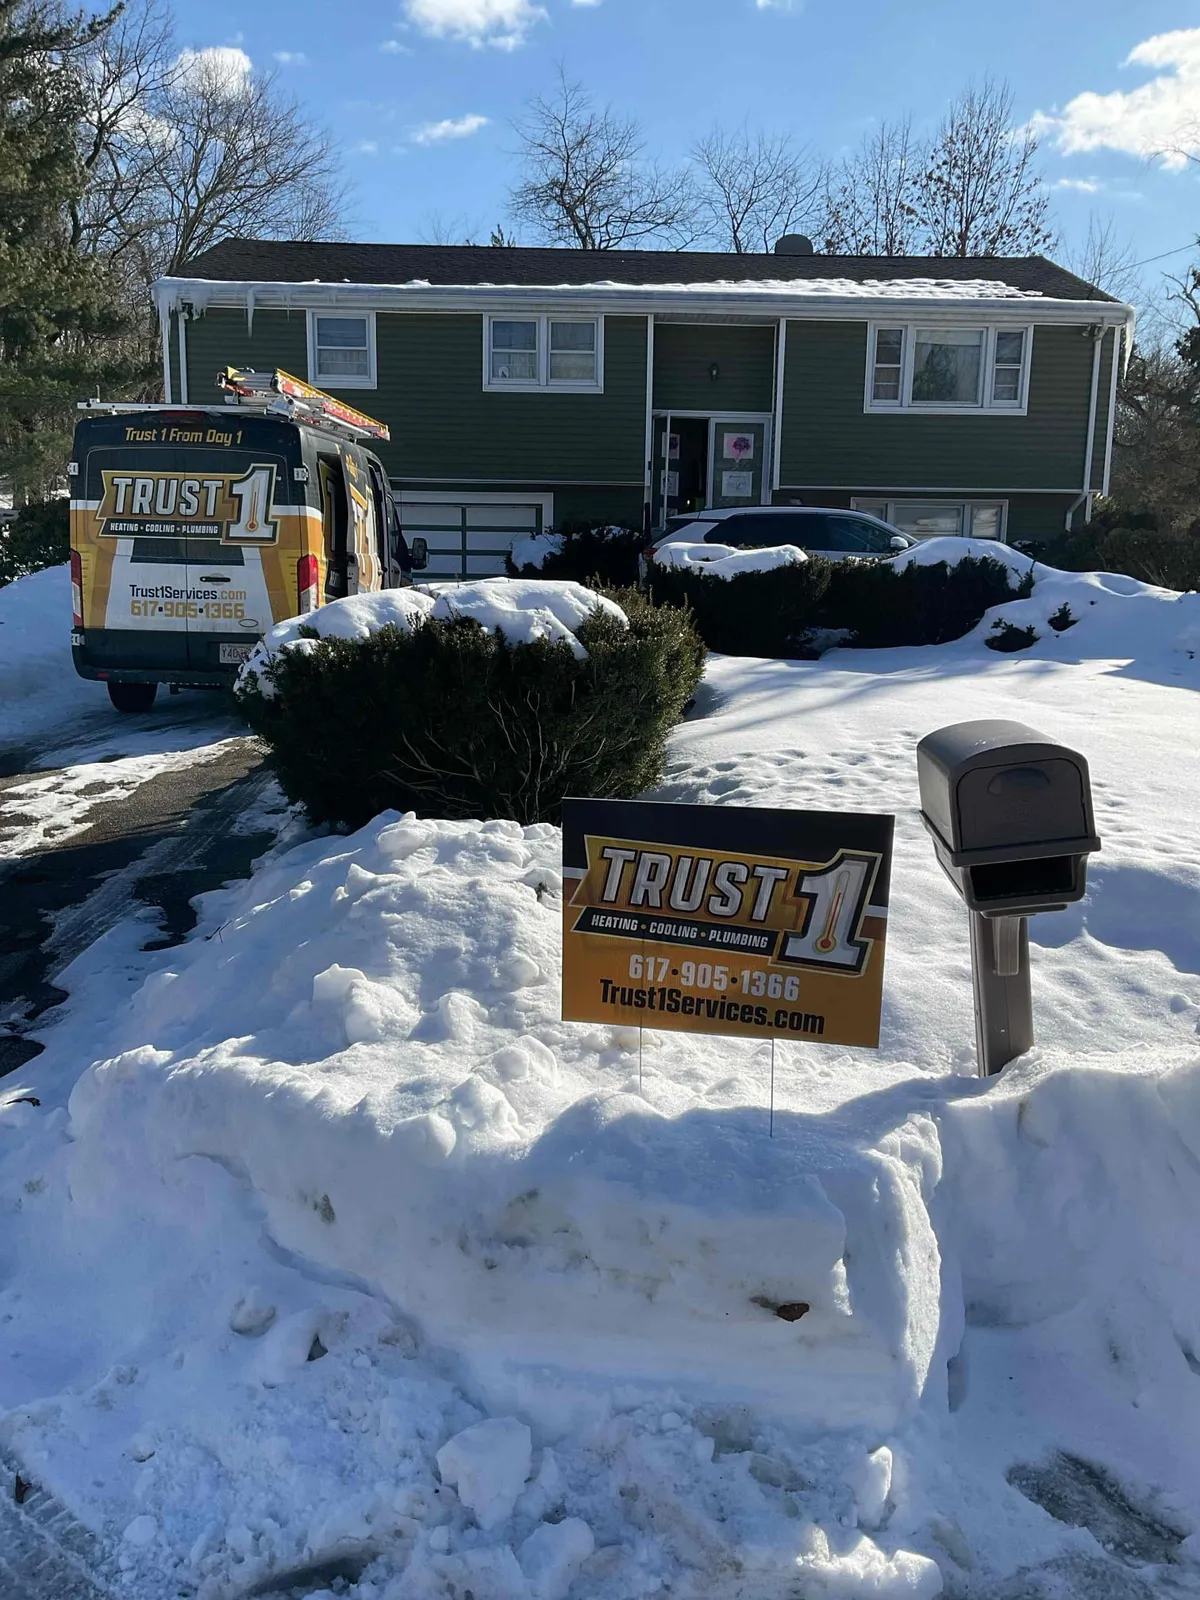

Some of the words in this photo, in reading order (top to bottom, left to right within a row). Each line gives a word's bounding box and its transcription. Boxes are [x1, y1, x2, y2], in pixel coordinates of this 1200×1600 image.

[125, 427, 157, 441] Trust
[161, 428, 167, 441] 1
[169, 428, 203, 442] From
[206, 429, 232, 446] Day
[236, 430, 243, 444] 1
[111, 476, 224, 517] TRUST
[229, 467, 276, 541] 1
[110, 522, 139, 533] HEATING
[145, 523, 175, 534] COOLING
[182, 524, 218, 535] PLUMBING
[129, 584, 247, 600] Trust1Services.com
[601, 846, 790, 922] TRUST
[784, 856, 870, 968] 1
[591, 914, 638, 932] HEATING
[649, 921, 698, 940] COOLING
[708, 929, 769, 949] PLUMBING
[599, 978, 825, 1035] Trust1Services.com
